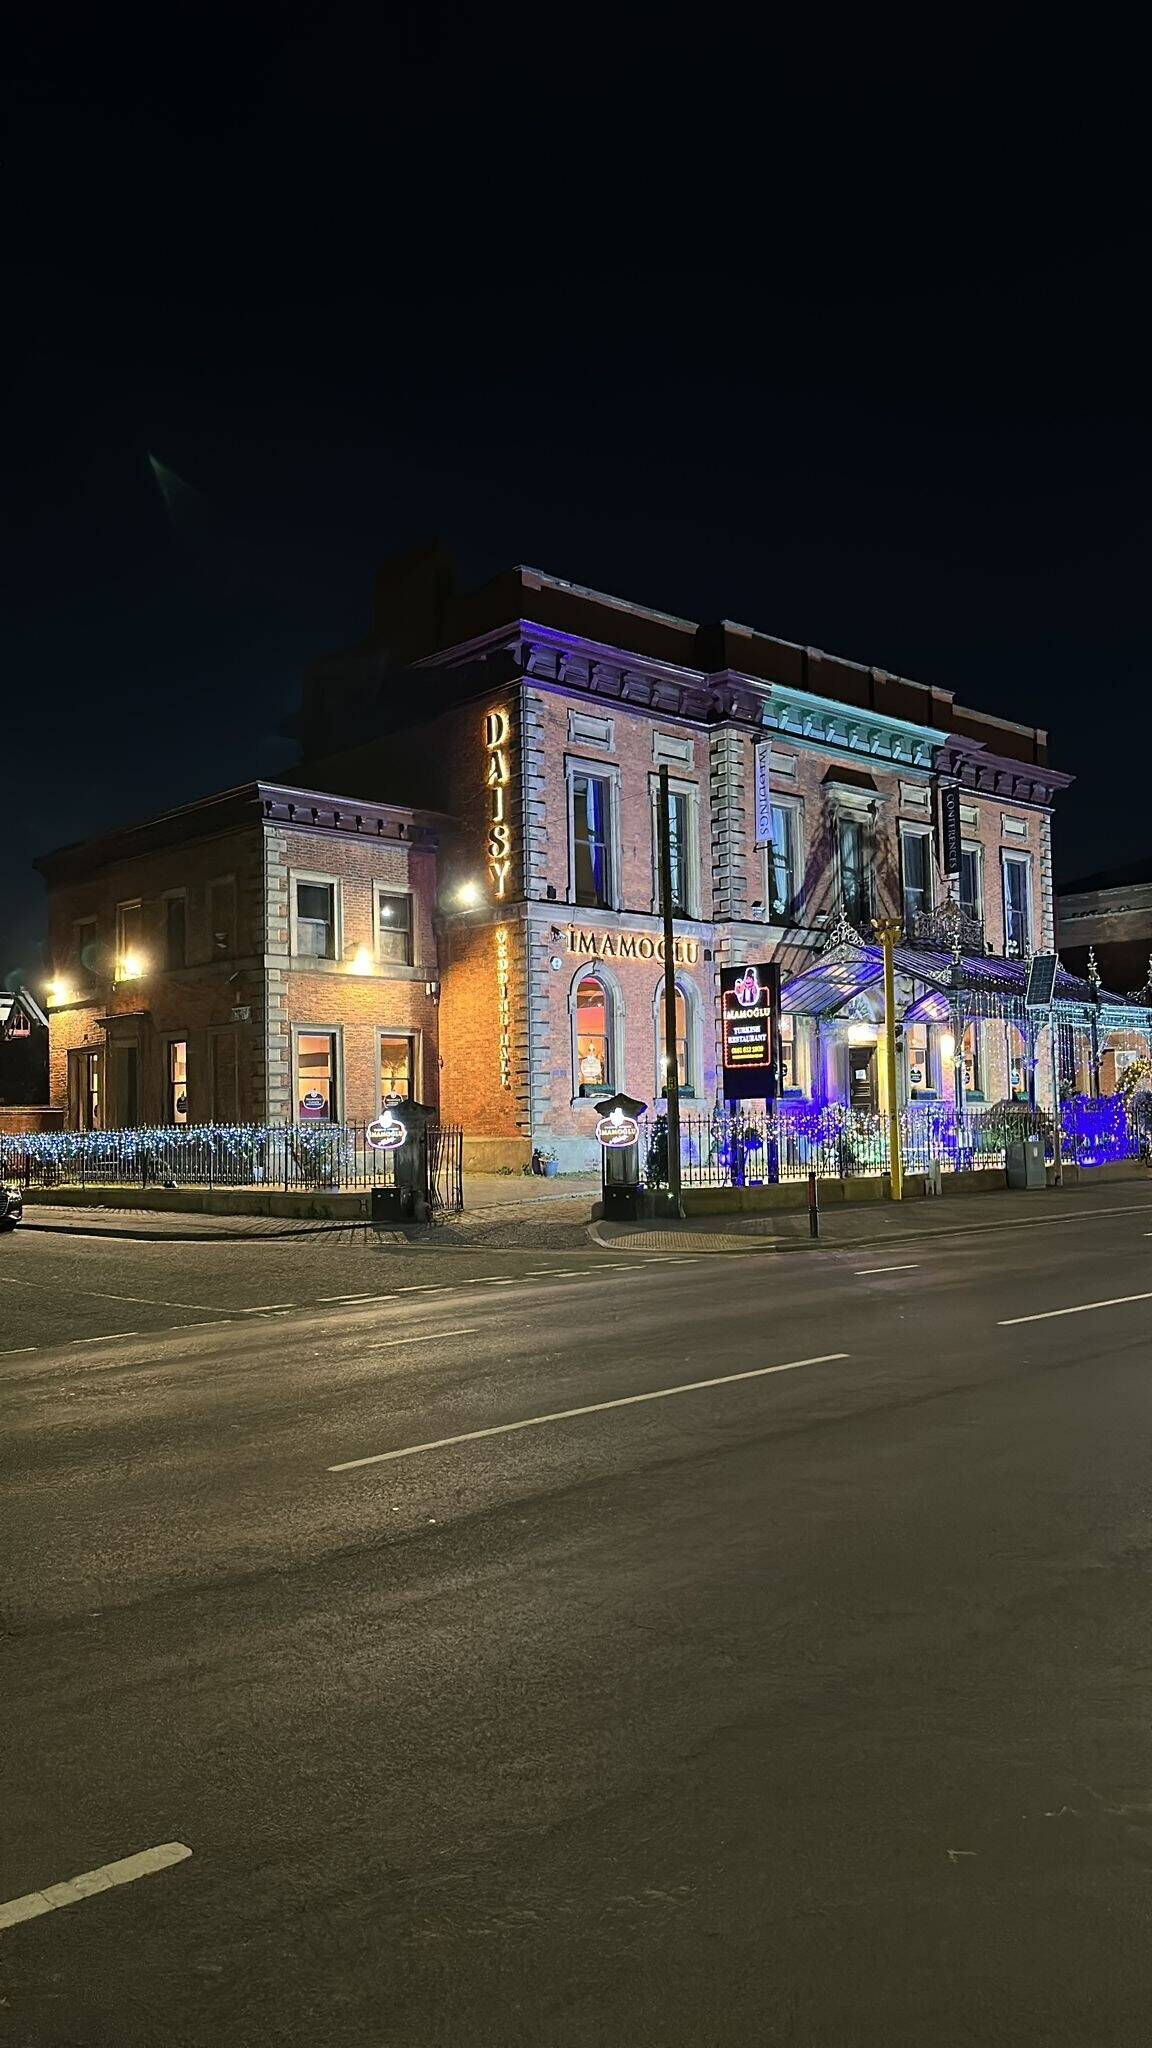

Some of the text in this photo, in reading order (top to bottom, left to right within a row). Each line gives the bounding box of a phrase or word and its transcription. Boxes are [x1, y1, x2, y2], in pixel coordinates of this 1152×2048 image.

[486, 713, 509, 898] DAISY
[759, 749, 769, 835] WEDDINGS
[946, 793, 958, 869] CONFERENCES
